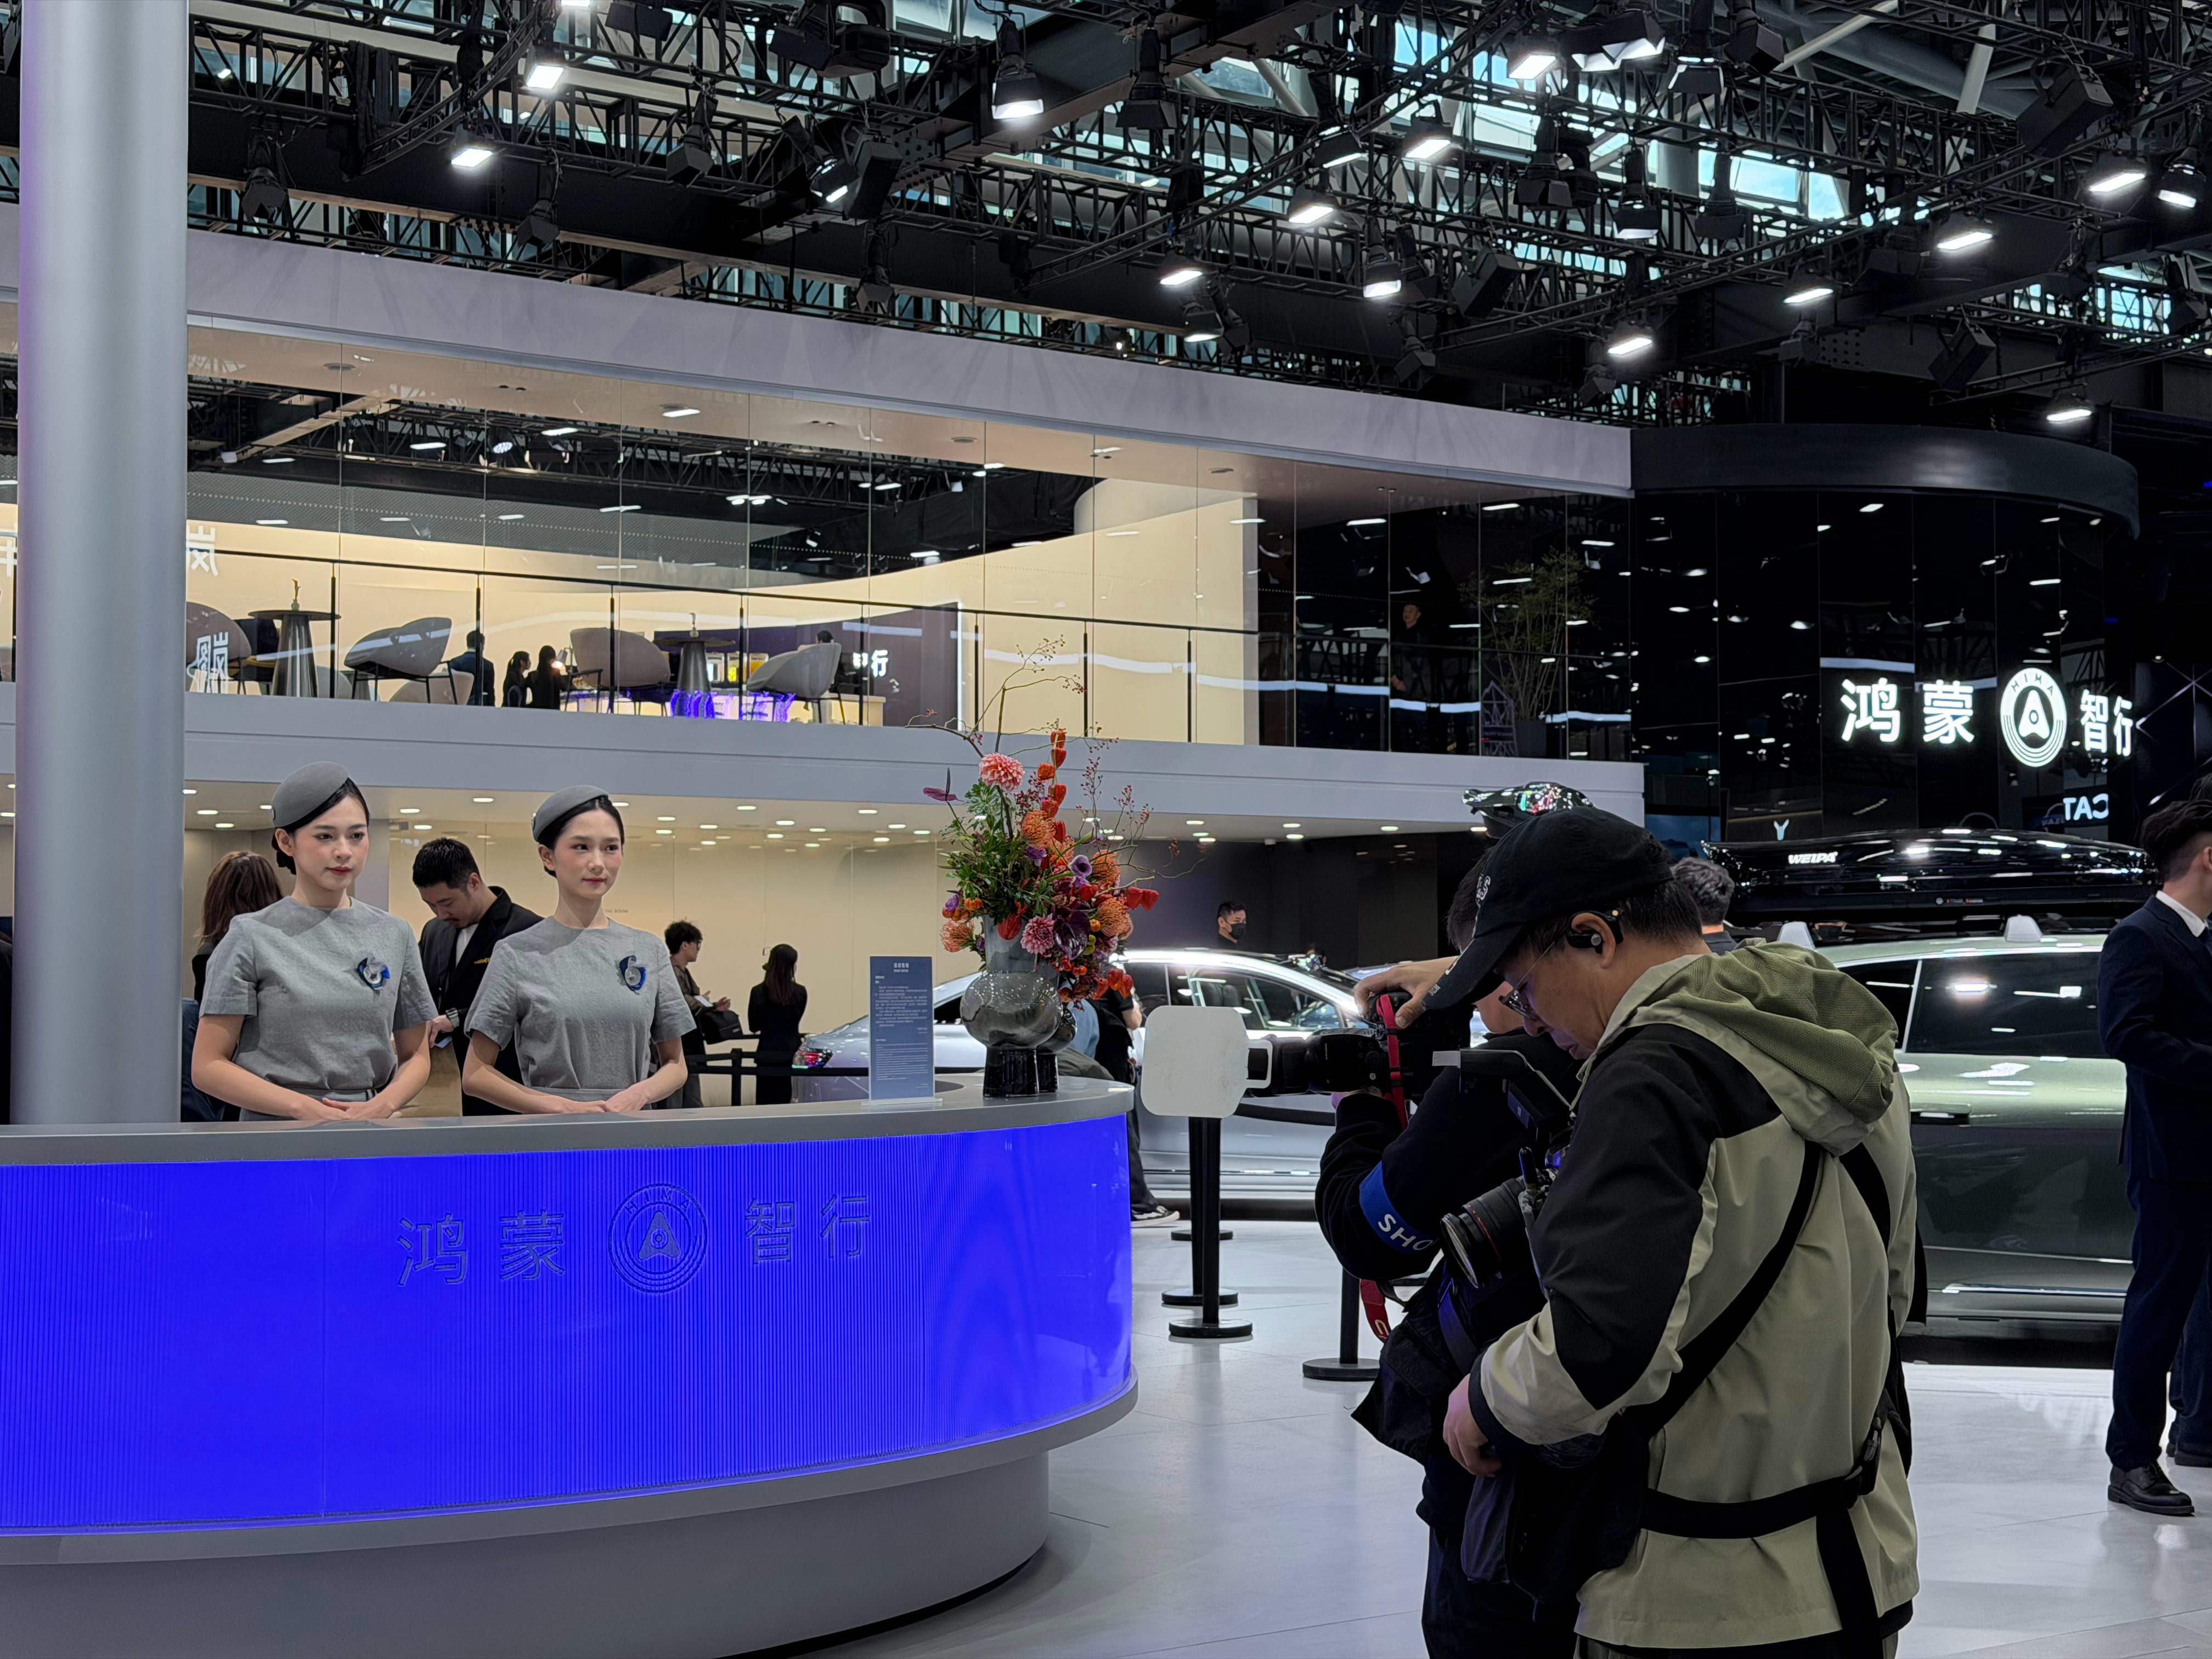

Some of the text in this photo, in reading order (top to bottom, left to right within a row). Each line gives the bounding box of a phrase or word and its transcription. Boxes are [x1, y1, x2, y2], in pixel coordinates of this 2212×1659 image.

[2011, 673, 2053, 696] HIMA
[1841, 677, 2133, 757] 鸿蒙 智行
[625, 1189, 690, 1215] HIMA
[397, 1193, 870, 1286] 鸿蒙 智行
[1378, 1214, 1440, 1251] SHO
